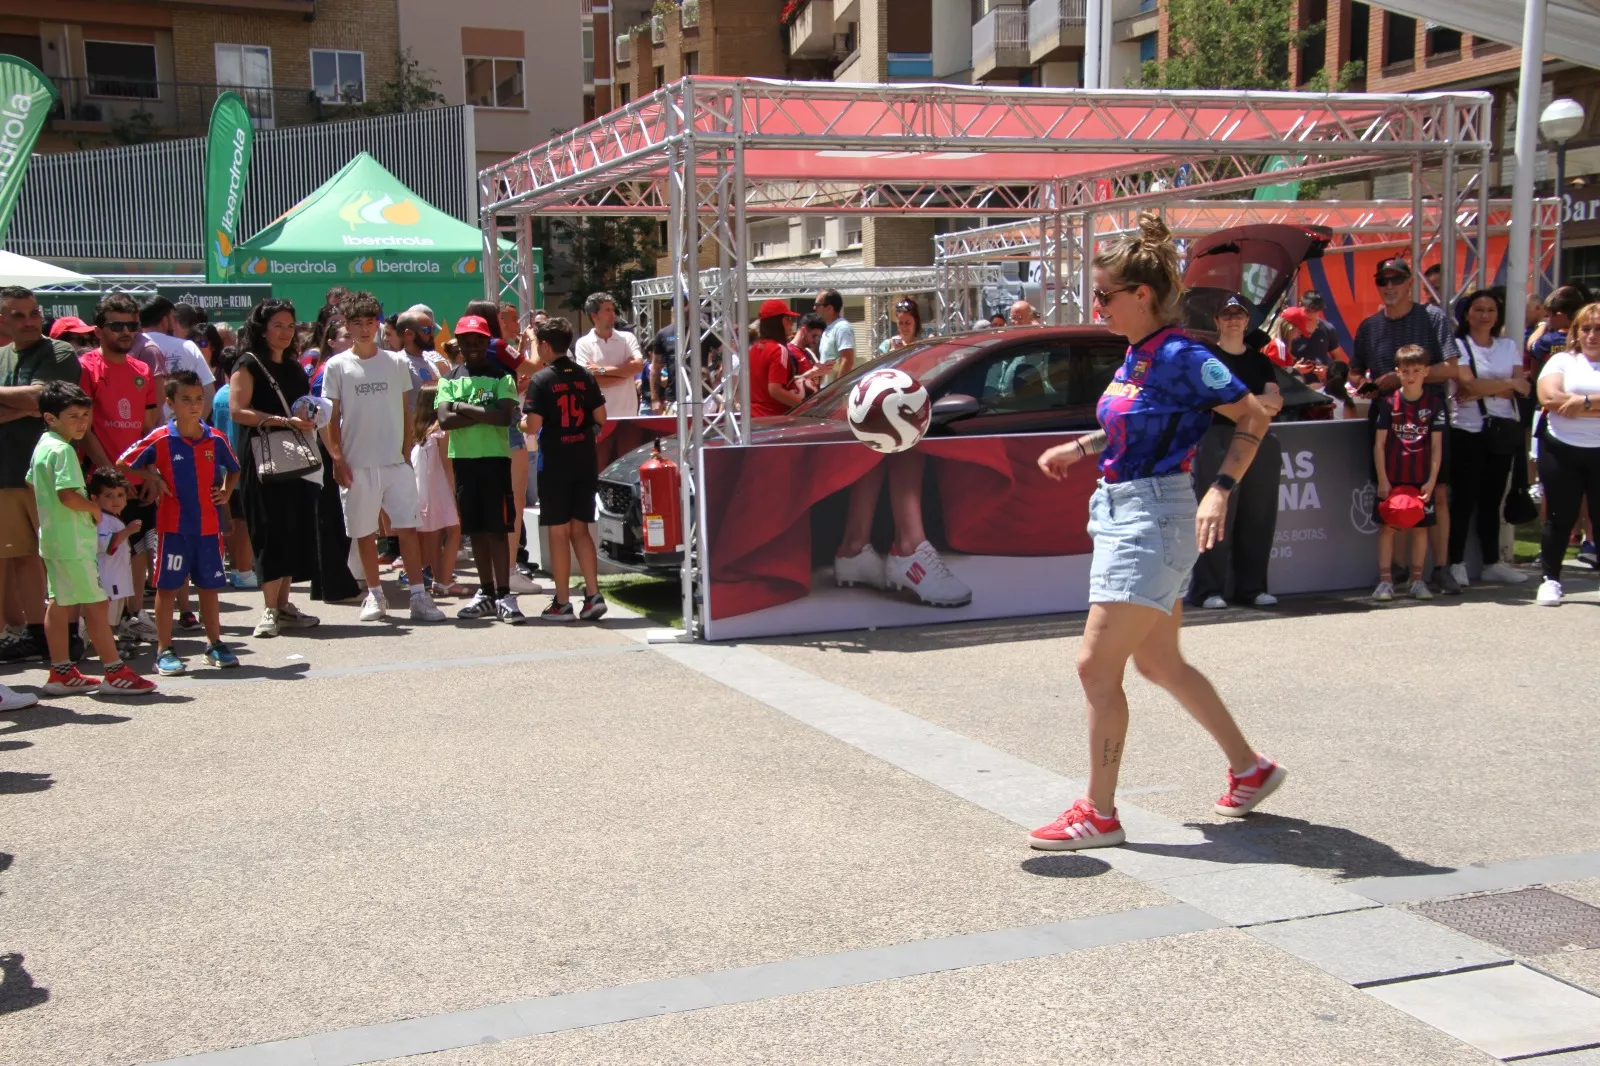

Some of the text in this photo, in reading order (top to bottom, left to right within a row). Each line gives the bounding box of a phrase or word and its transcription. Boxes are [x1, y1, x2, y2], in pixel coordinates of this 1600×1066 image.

[222, 128, 246, 233] Iberdrola
[1562, 193, 1600, 222] Bar
[342, 234, 435, 246] Iberdrola
[270, 260, 337, 273] Iberdrola
[376, 260, 440, 273] Iberdrola
[204, 295, 252, 308] COPA REINA
[52, 304, 79, 318] REINA
[354, 382, 389, 395] KENZO
[1280, 450, 1315, 480] AS
[1278, 482, 1321, 511] NA
[1273, 530, 1290, 542] AS
[1281, 546, 1293, 558] IG
[167, 553, 183, 571] 10
